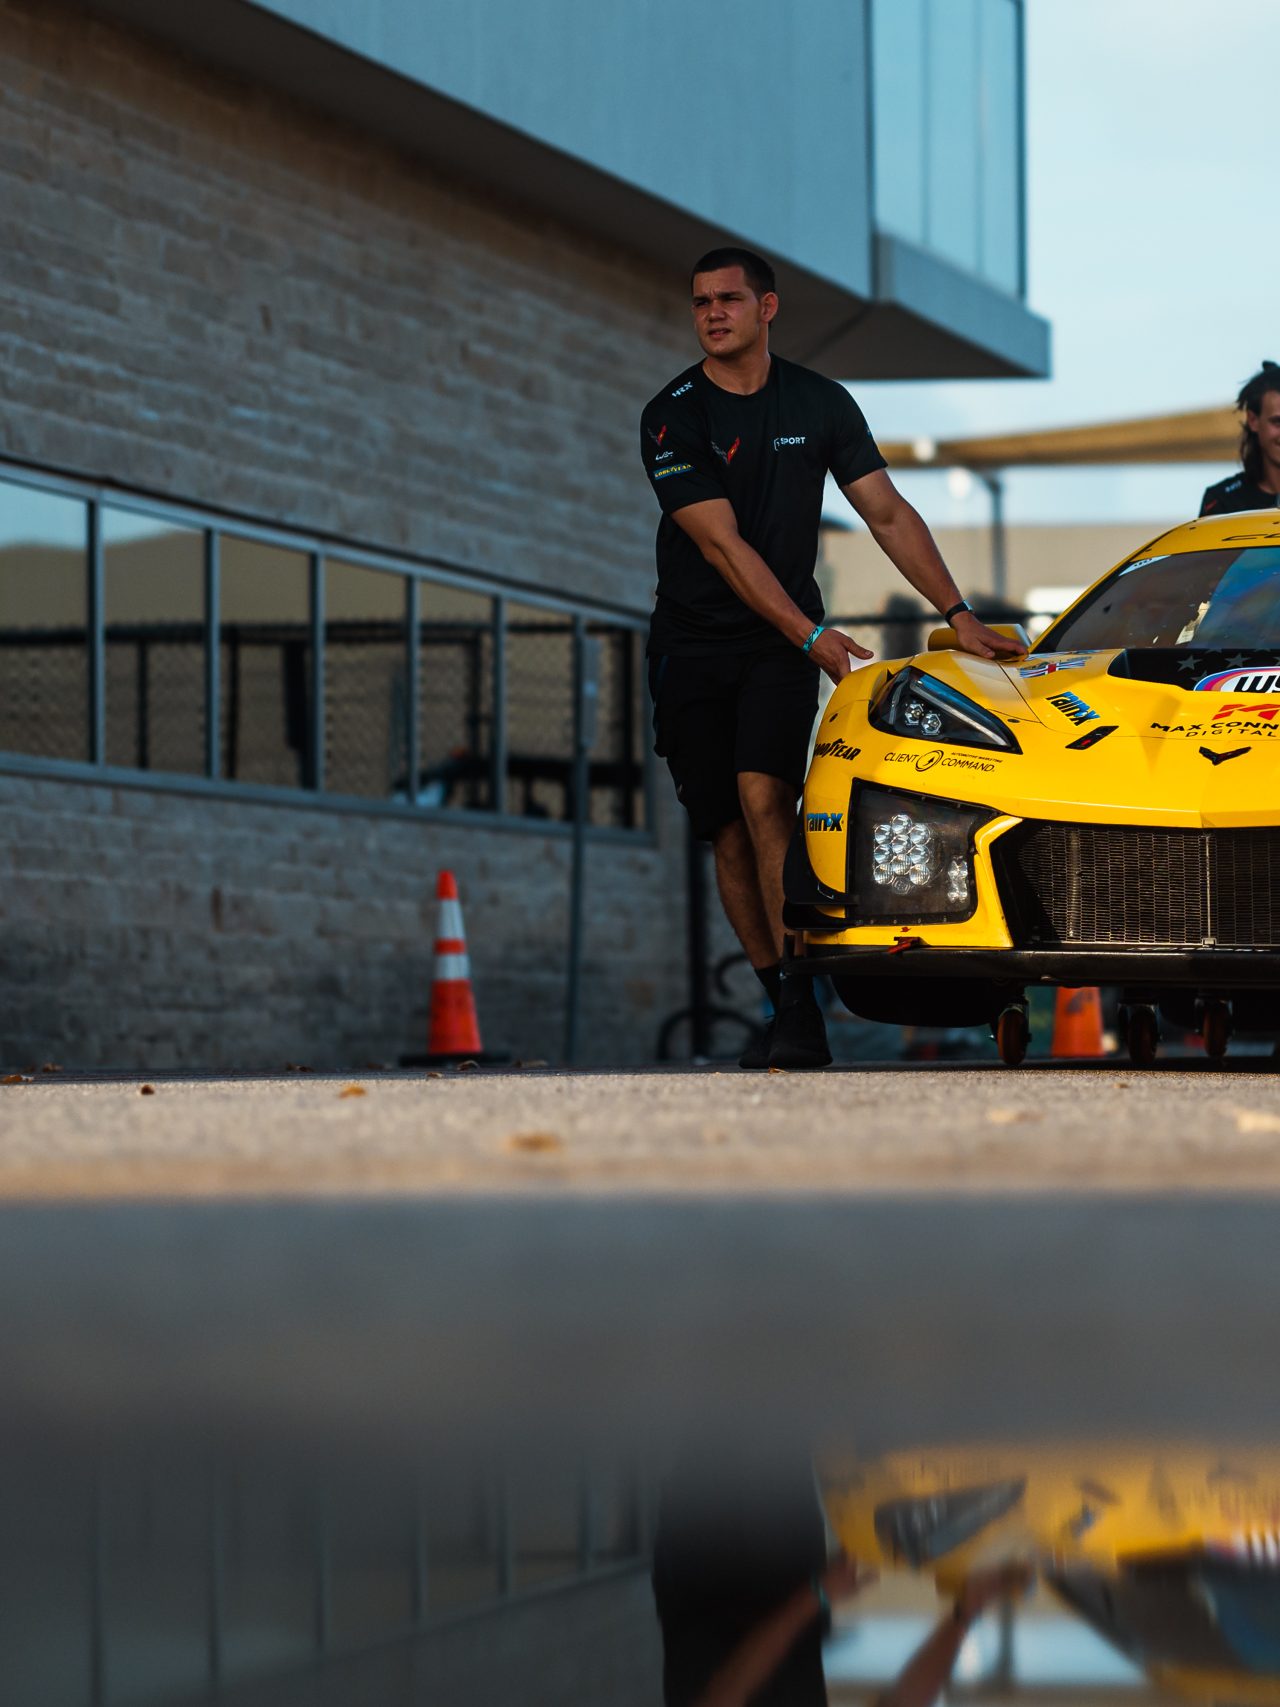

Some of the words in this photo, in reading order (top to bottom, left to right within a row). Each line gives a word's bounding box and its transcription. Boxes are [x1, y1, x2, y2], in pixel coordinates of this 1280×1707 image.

[780, 436, 806, 445] SPORT
[1150, 721, 1201, 733] MAX
[1185, 728, 1277, 738] DIGITAL
[884, 752, 919, 763] CLIENT
